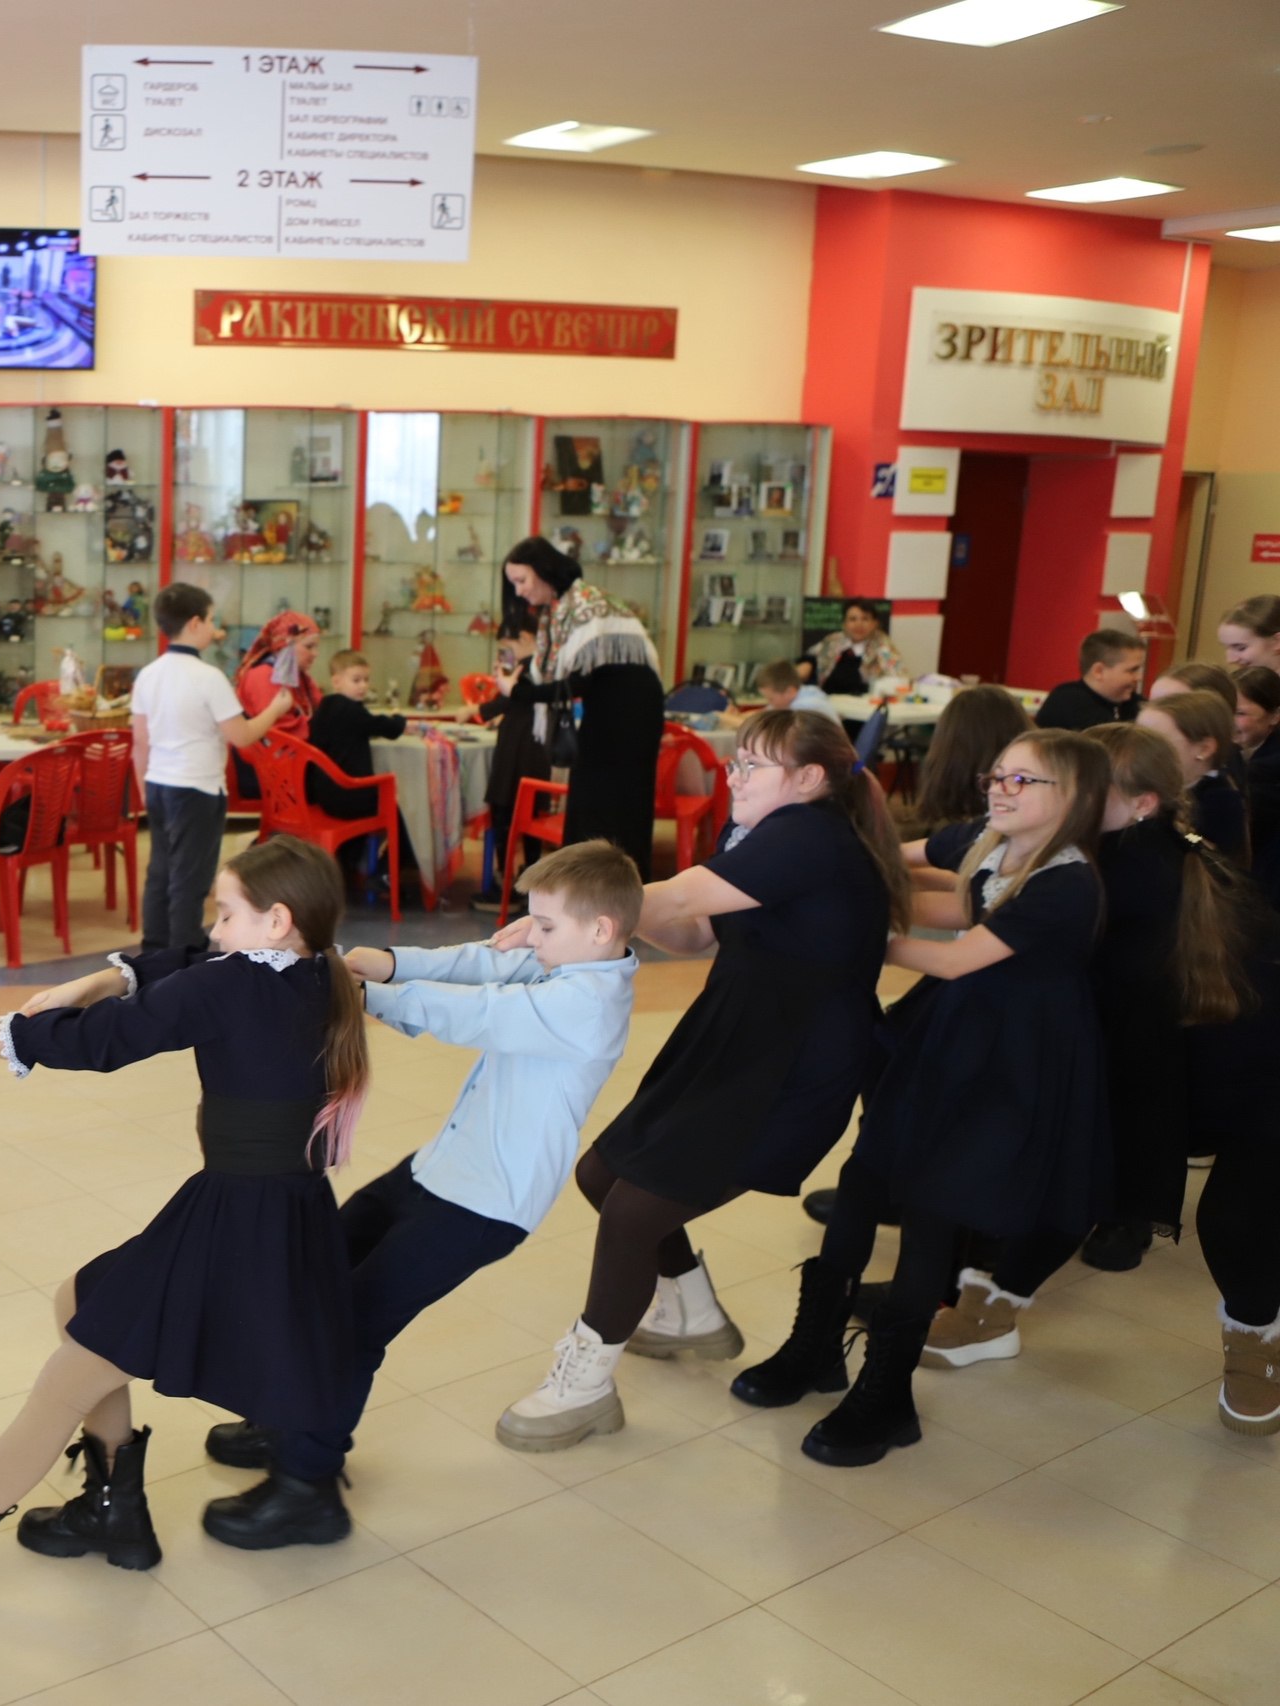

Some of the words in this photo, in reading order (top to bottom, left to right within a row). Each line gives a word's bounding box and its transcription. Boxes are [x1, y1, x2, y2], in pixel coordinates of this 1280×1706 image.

[243, 55, 251, 73] 1
[258, 55, 325, 74] ЭТАЖ
[143, 81, 199, 92] ГАРДЕРОБ
[332, 82, 353, 91] ЗАЛ
[144, 97, 184, 107] ТУАЛЕТ
[289, 96, 328, 106] ТУАЛЕТ
[288, 114, 310, 123] ЗАЛ
[312, 114, 388, 125] ХОРЕОГРАФИИ
[143, 127, 203, 137] ДИСКОЗАЛ
[287, 131, 335, 141] КАБИНЕТ
[337, 132, 398, 142] ДИРЕКТОРА
[287, 149, 343, 158] КАБИНЕТЫ
[346, 149, 429, 161] СПЕЦИАЛИСТОВ
[237, 169, 249, 188] 2
[257, 169, 323, 189] ЭТАЖ
[128, 211, 150, 221] ЗАЛ
[152, 211, 210, 222] ТОРЖЕСТВ
[285, 217, 310, 227] ДОМ
[312, 217, 361, 228] РЕМЕСЕЛ
[127, 233, 185, 243] КАБИНЕТЫ
[188, 233, 274, 244] СПЕЦИАЛИСТОВ
[284, 236, 340, 246] КАБИНЕТЫ
[343, 236, 426, 248] СПЕЦИАЛИСТОВ
[218, 298, 497, 344] РАКИТЯНСКИЙ
[934, 322, 1173, 384] ЗРИТЕЛЬНЫЙ
[1035, 372, 1106, 415] ЗАЛ
